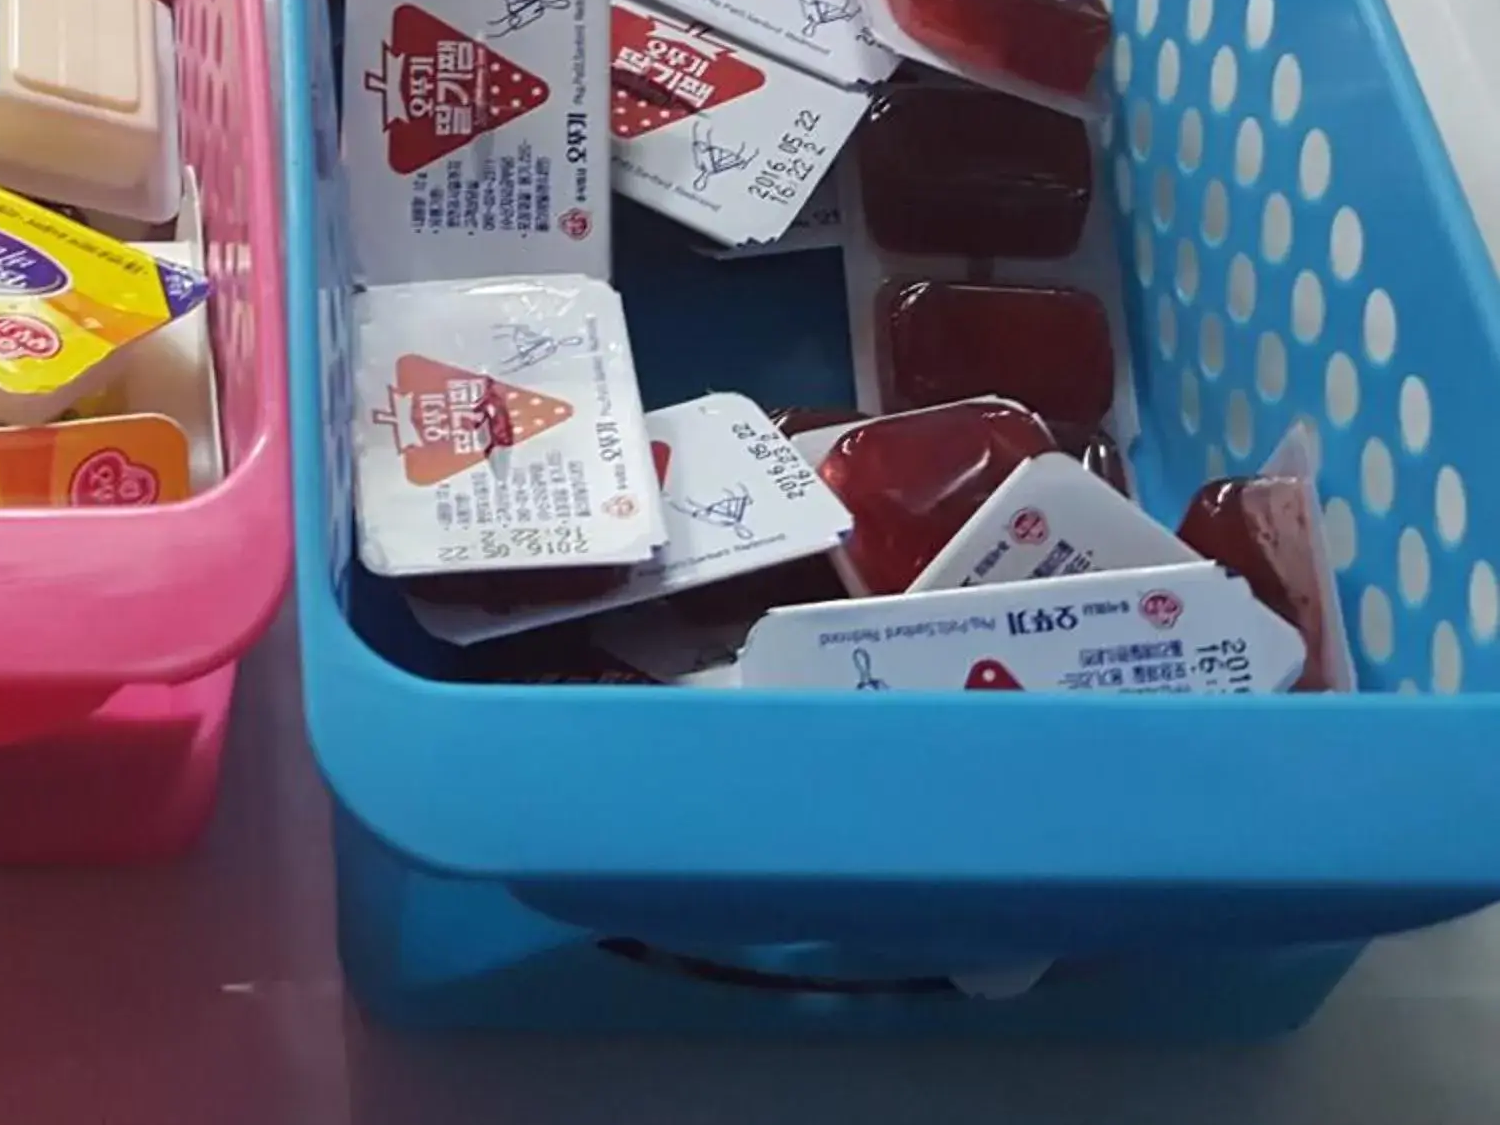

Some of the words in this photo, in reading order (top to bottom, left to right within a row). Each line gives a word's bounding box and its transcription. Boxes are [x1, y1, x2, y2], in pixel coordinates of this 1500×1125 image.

[647, 39, 709, 77] 오뚜기
[409, 56, 436, 118] 오뚜기
[435, 39, 474, 136] 딸기쨈
[566, 112, 589, 164] 오뚜기
[418, 393, 448, 441] 오뚜기
[596, 421, 622, 461] 오뚜기
[1006, 605, 1079, 635] 오뚜기
